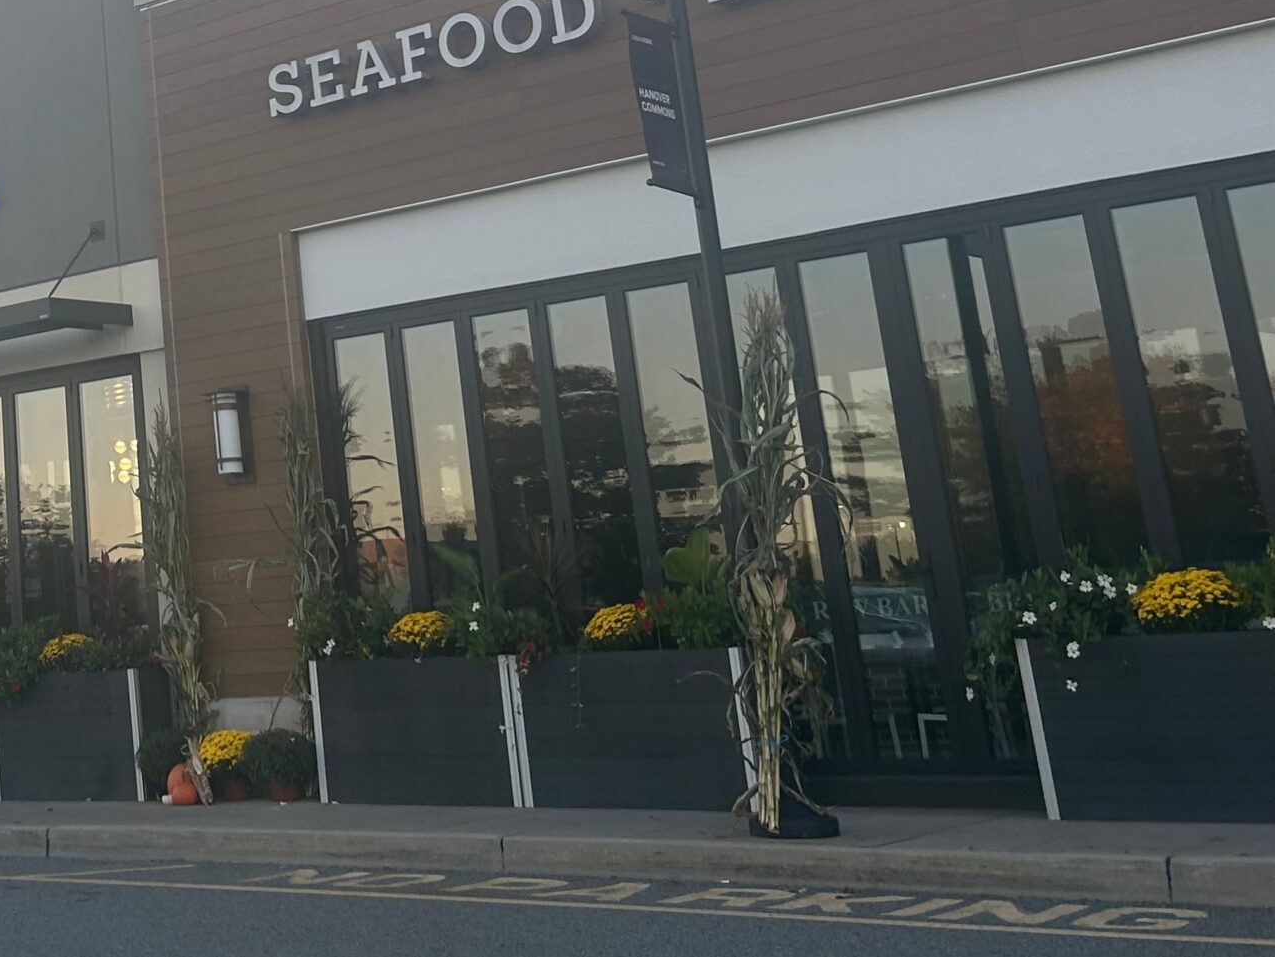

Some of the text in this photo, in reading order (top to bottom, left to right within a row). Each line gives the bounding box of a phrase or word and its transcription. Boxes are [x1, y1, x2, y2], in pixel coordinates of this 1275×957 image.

[639, 87, 671, 104] HANOVER
[641, 101, 676, 120] COMMONS
[238, 868, 1207, 931] NO PARKING
